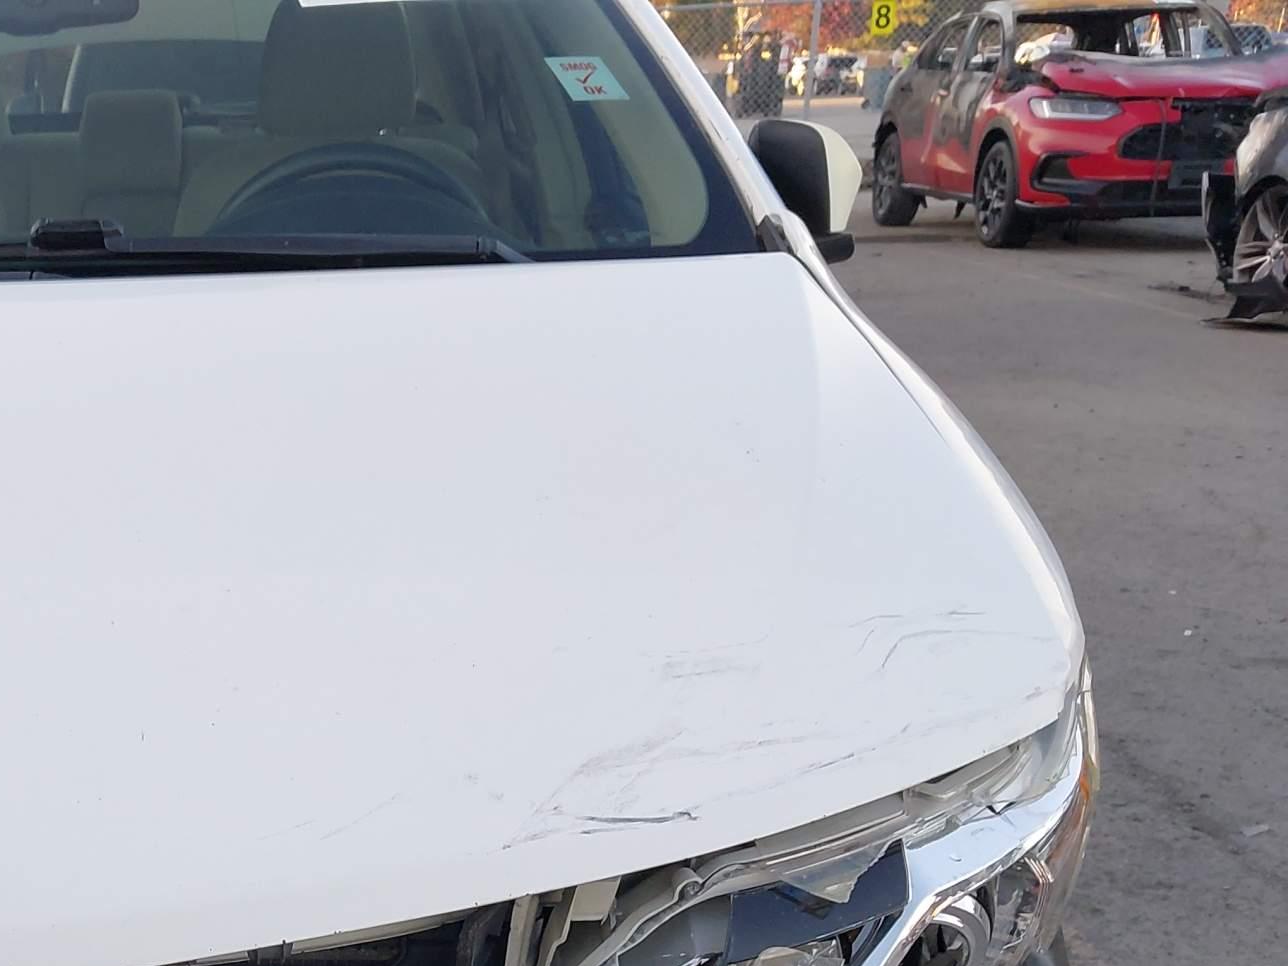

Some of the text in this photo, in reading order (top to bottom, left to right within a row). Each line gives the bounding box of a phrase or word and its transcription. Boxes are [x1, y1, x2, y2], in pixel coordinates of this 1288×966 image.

[875, 4, 891, 29] 8
[559, 63, 597, 72] SMOG
[583, 86, 607, 95] OK
